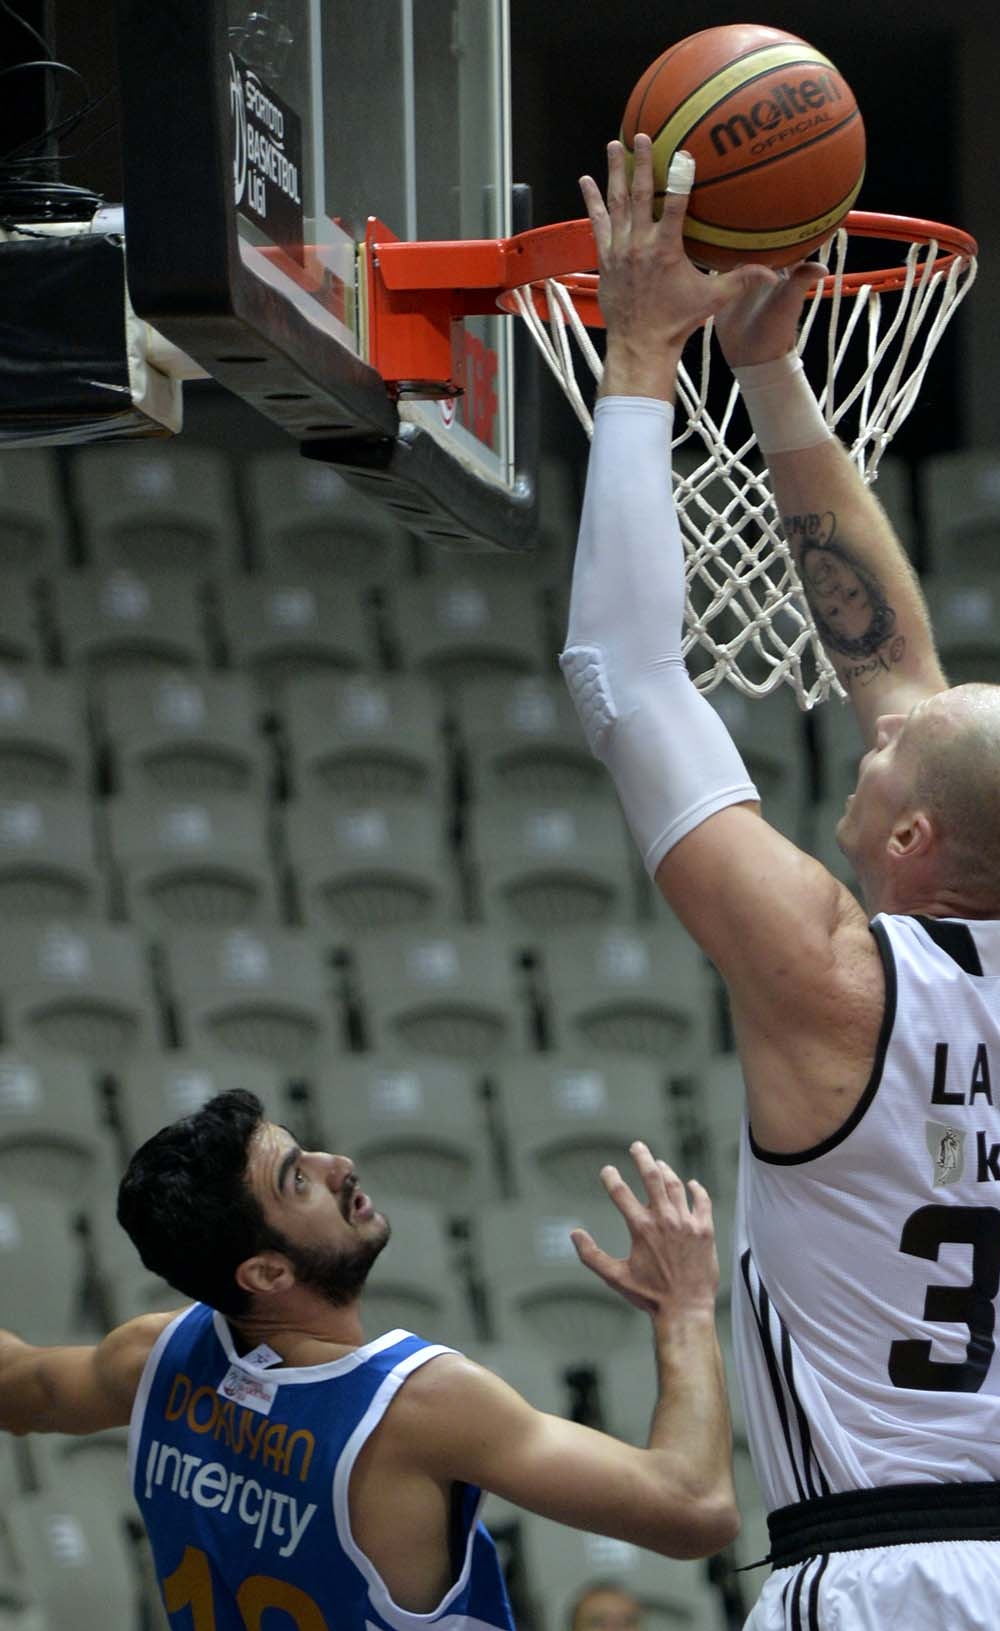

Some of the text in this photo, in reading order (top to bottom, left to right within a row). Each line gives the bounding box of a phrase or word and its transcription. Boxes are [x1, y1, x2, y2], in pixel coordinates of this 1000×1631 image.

[709, 73, 842, 157] molten
[751, 112, 834, 154] OFFICIAL
[247, 122, 301, 206] BASKETBOL
